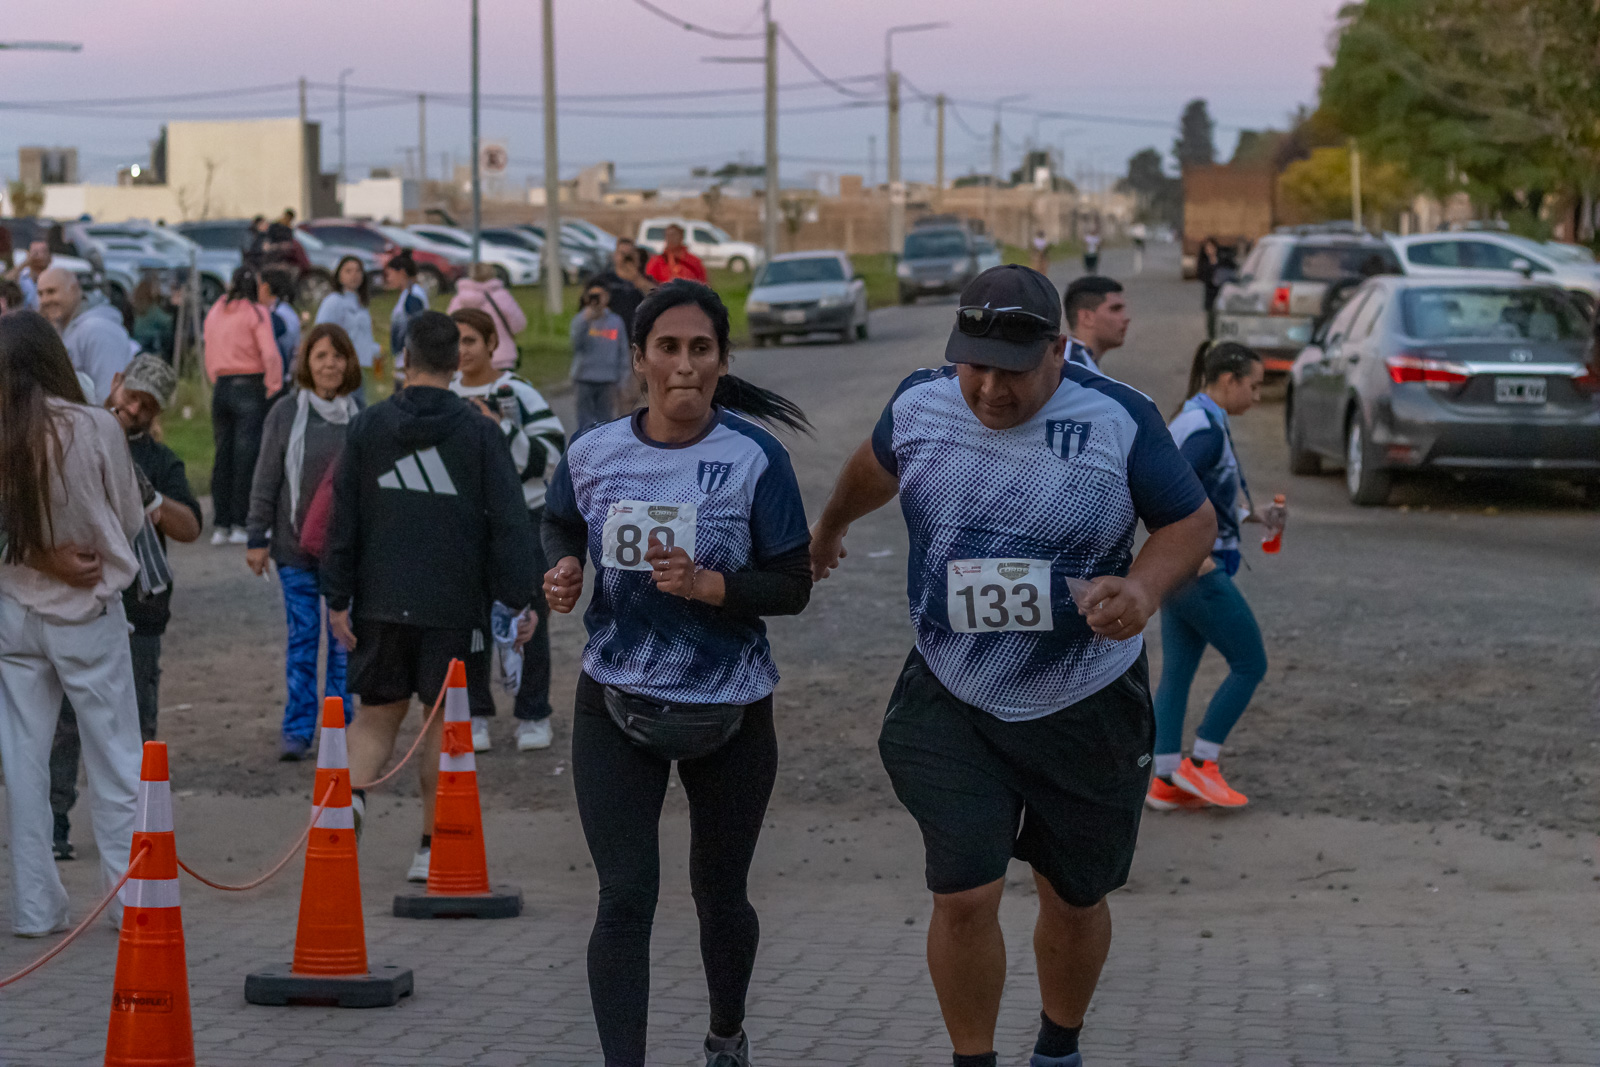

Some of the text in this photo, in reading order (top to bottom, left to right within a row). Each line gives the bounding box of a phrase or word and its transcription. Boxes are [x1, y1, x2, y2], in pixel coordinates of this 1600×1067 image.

[1053, 422, 1083, 434] SFC
[703, 463, 728, 473] SFC
[955, 583, 1042, 629] 133
